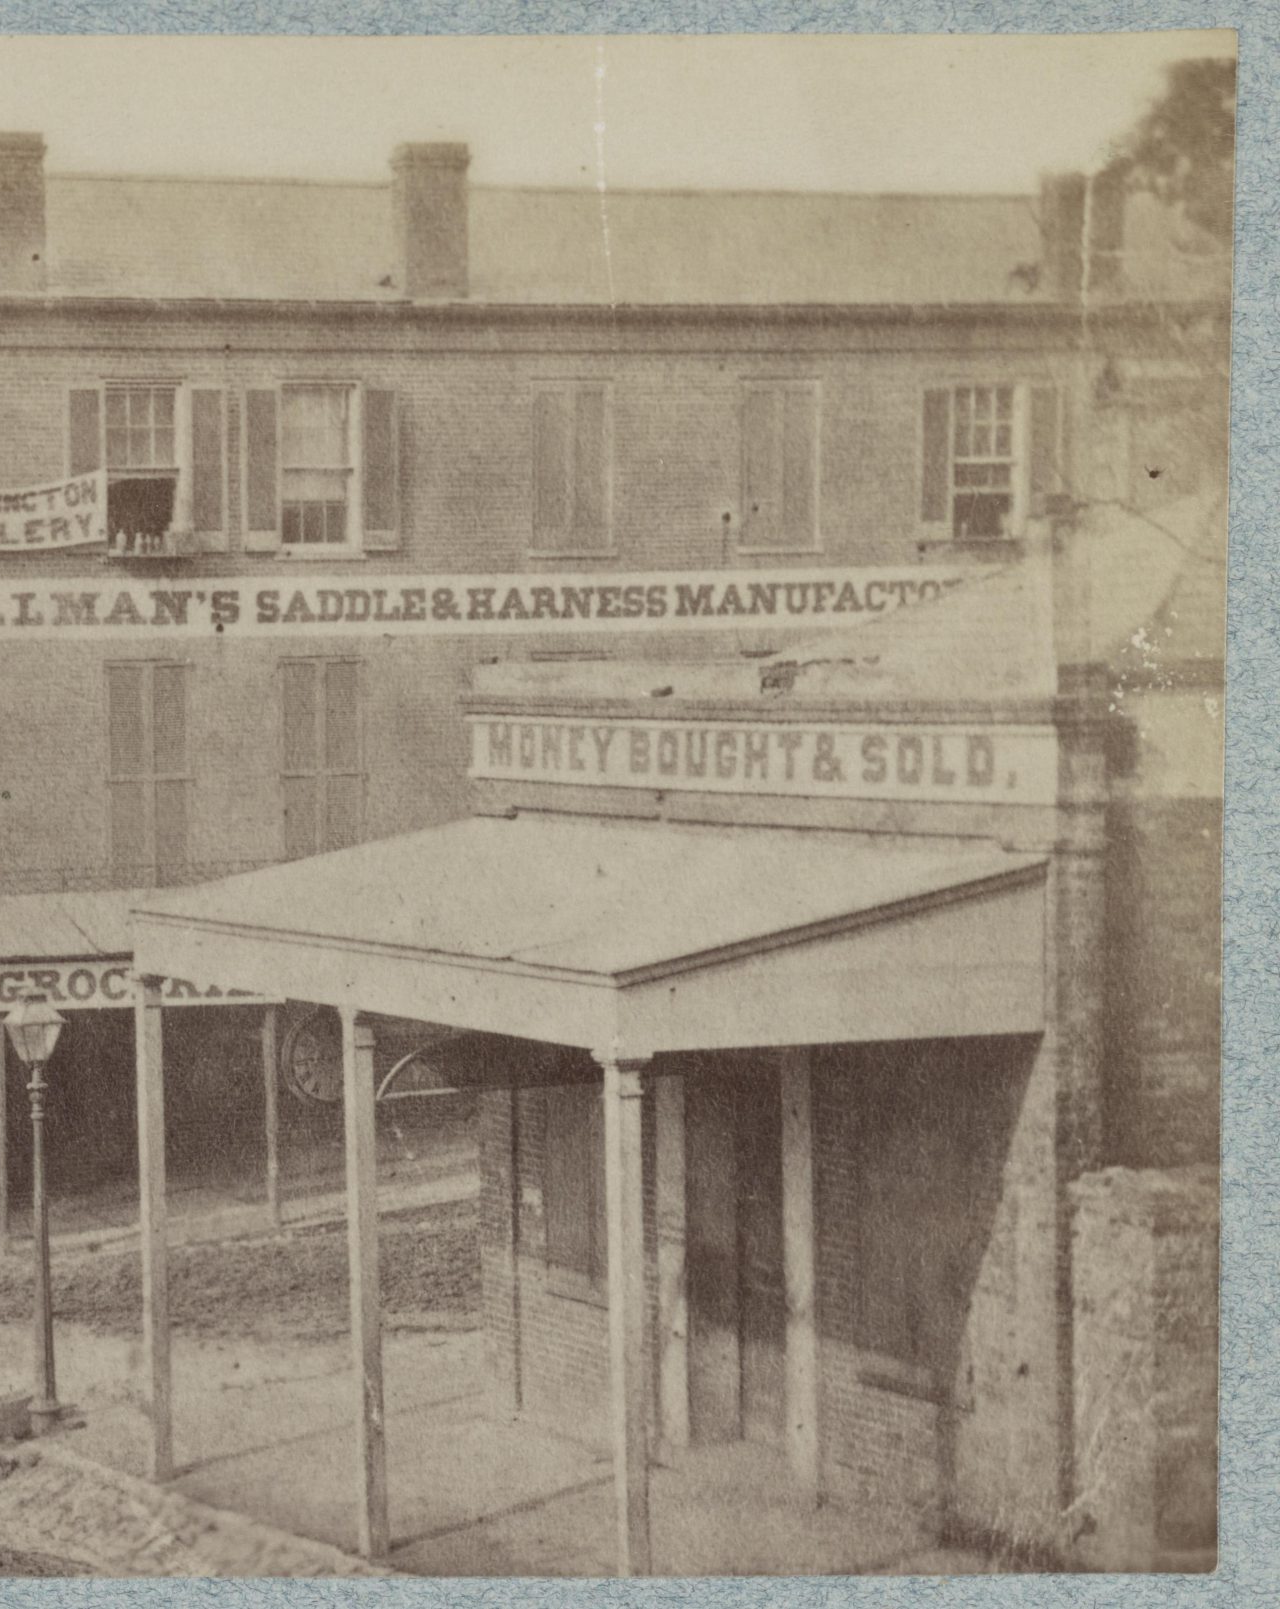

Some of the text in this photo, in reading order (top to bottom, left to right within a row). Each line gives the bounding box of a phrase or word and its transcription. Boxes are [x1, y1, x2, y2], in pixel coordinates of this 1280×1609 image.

[255, 588, 428, 624] SADDLE
[465, 584, 668, 621] HARNESS
[673, 578, 962, 617] MANUFACTO
[488, 721, 618, 772] MONEY
[628, 726, 802, 781] BOUGHT
[811, 730, 847, 782] &
